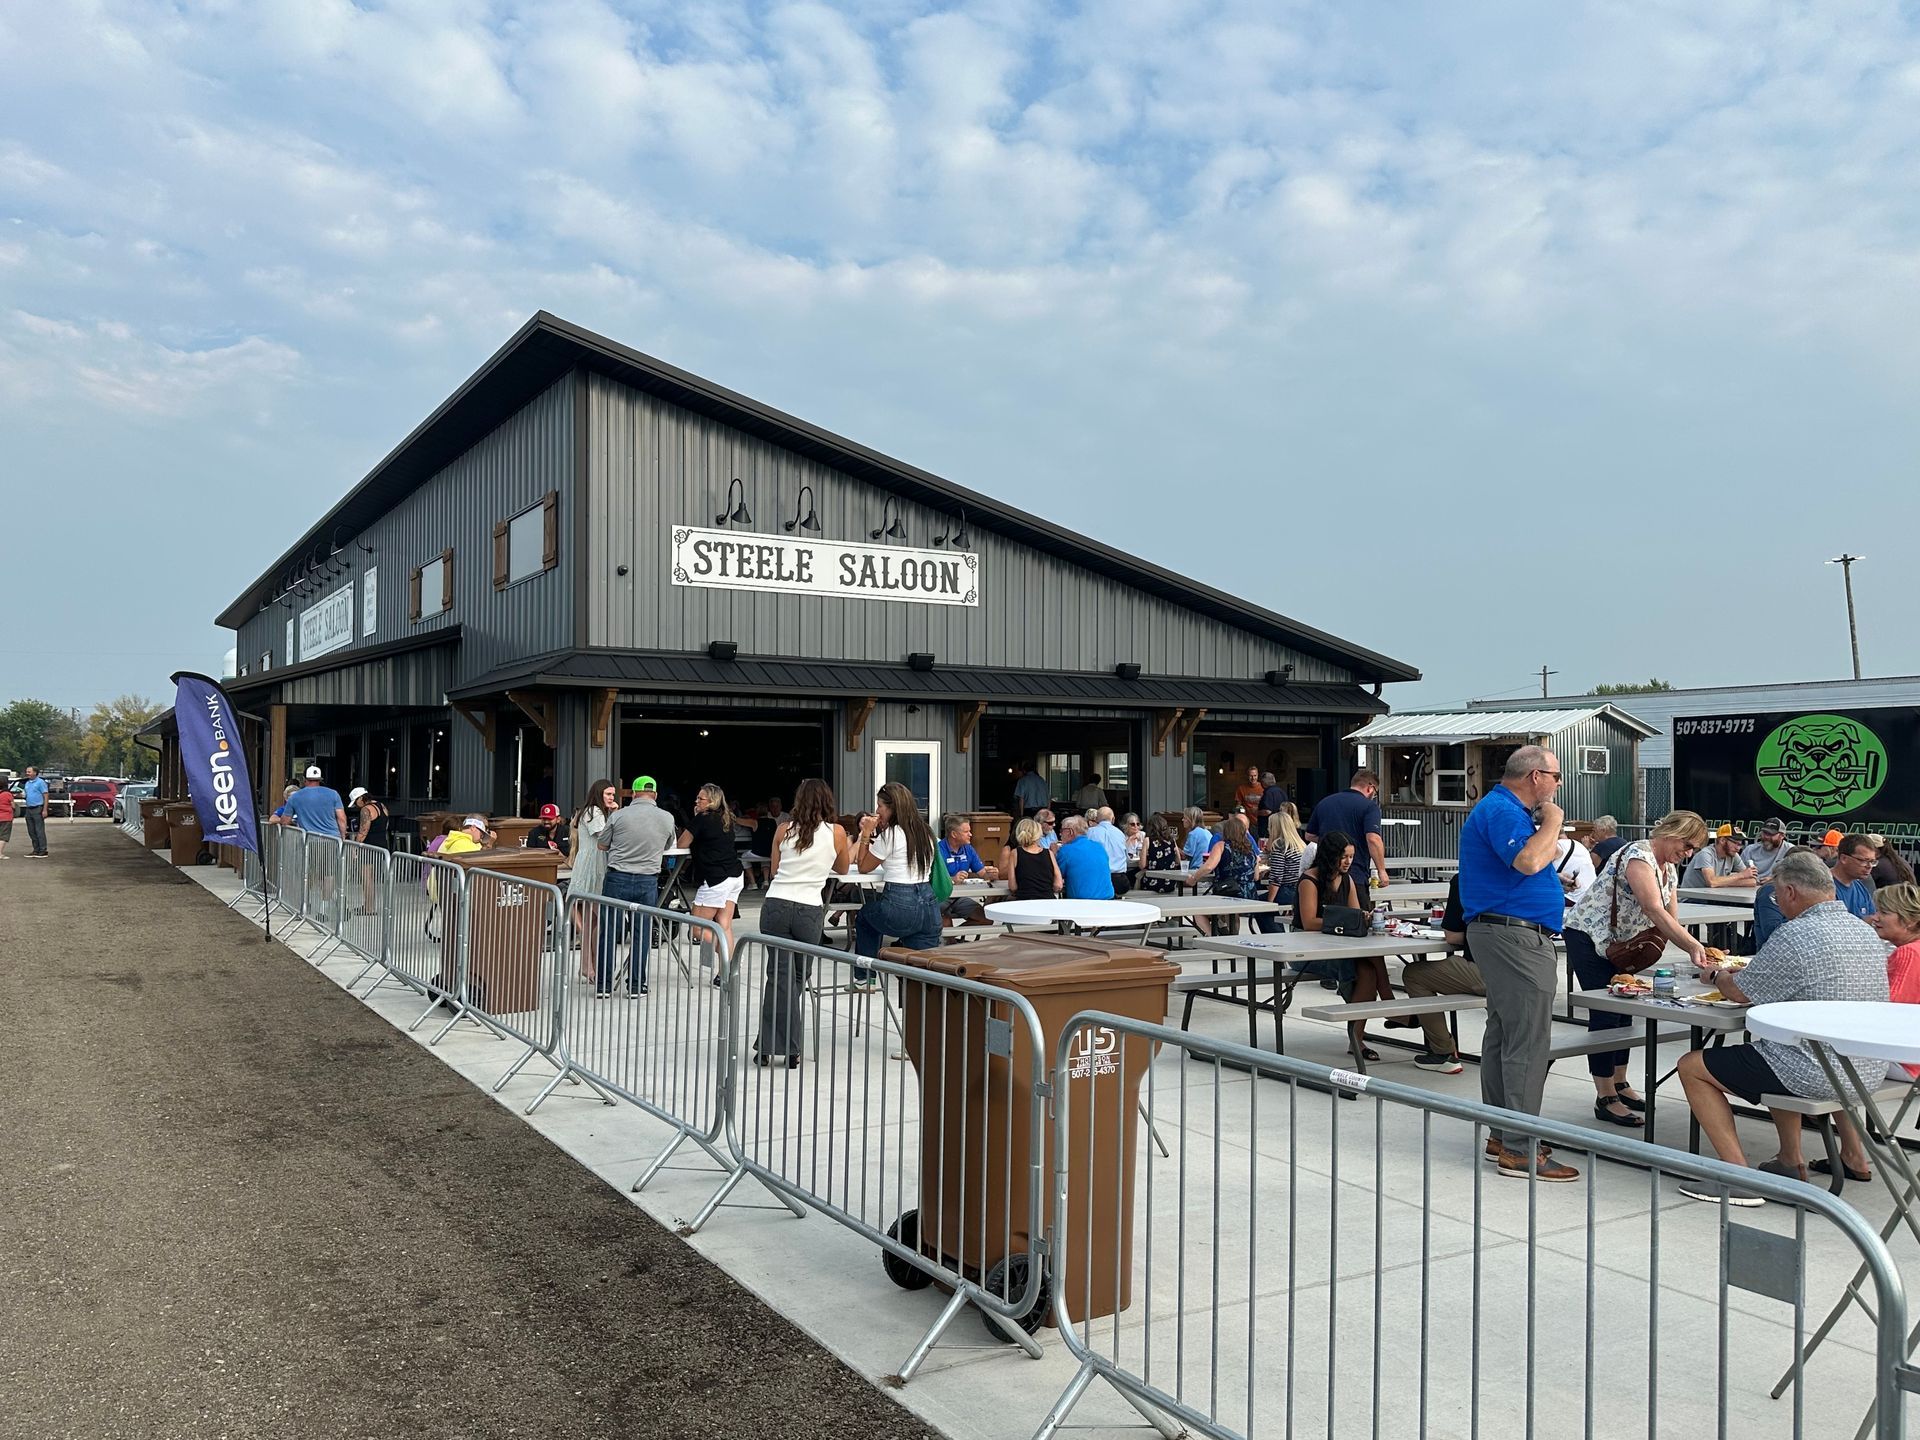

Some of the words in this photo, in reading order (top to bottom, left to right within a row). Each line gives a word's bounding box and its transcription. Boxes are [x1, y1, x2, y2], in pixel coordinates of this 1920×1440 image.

[693, 539, 814, 584] STEELE
[839, 553, 961, 595] SALOON
[205, 693, 227, 741] BANK
[1676, 718, 1755, 735] 507-837-9773
[209, 750, 240, 832] keen
[1810, 821, 1920, 843] CATIN
[1071, 1065, 1116, 1079] 507-26-4370
[1077, 1056, 1112, 1068] THOSON
